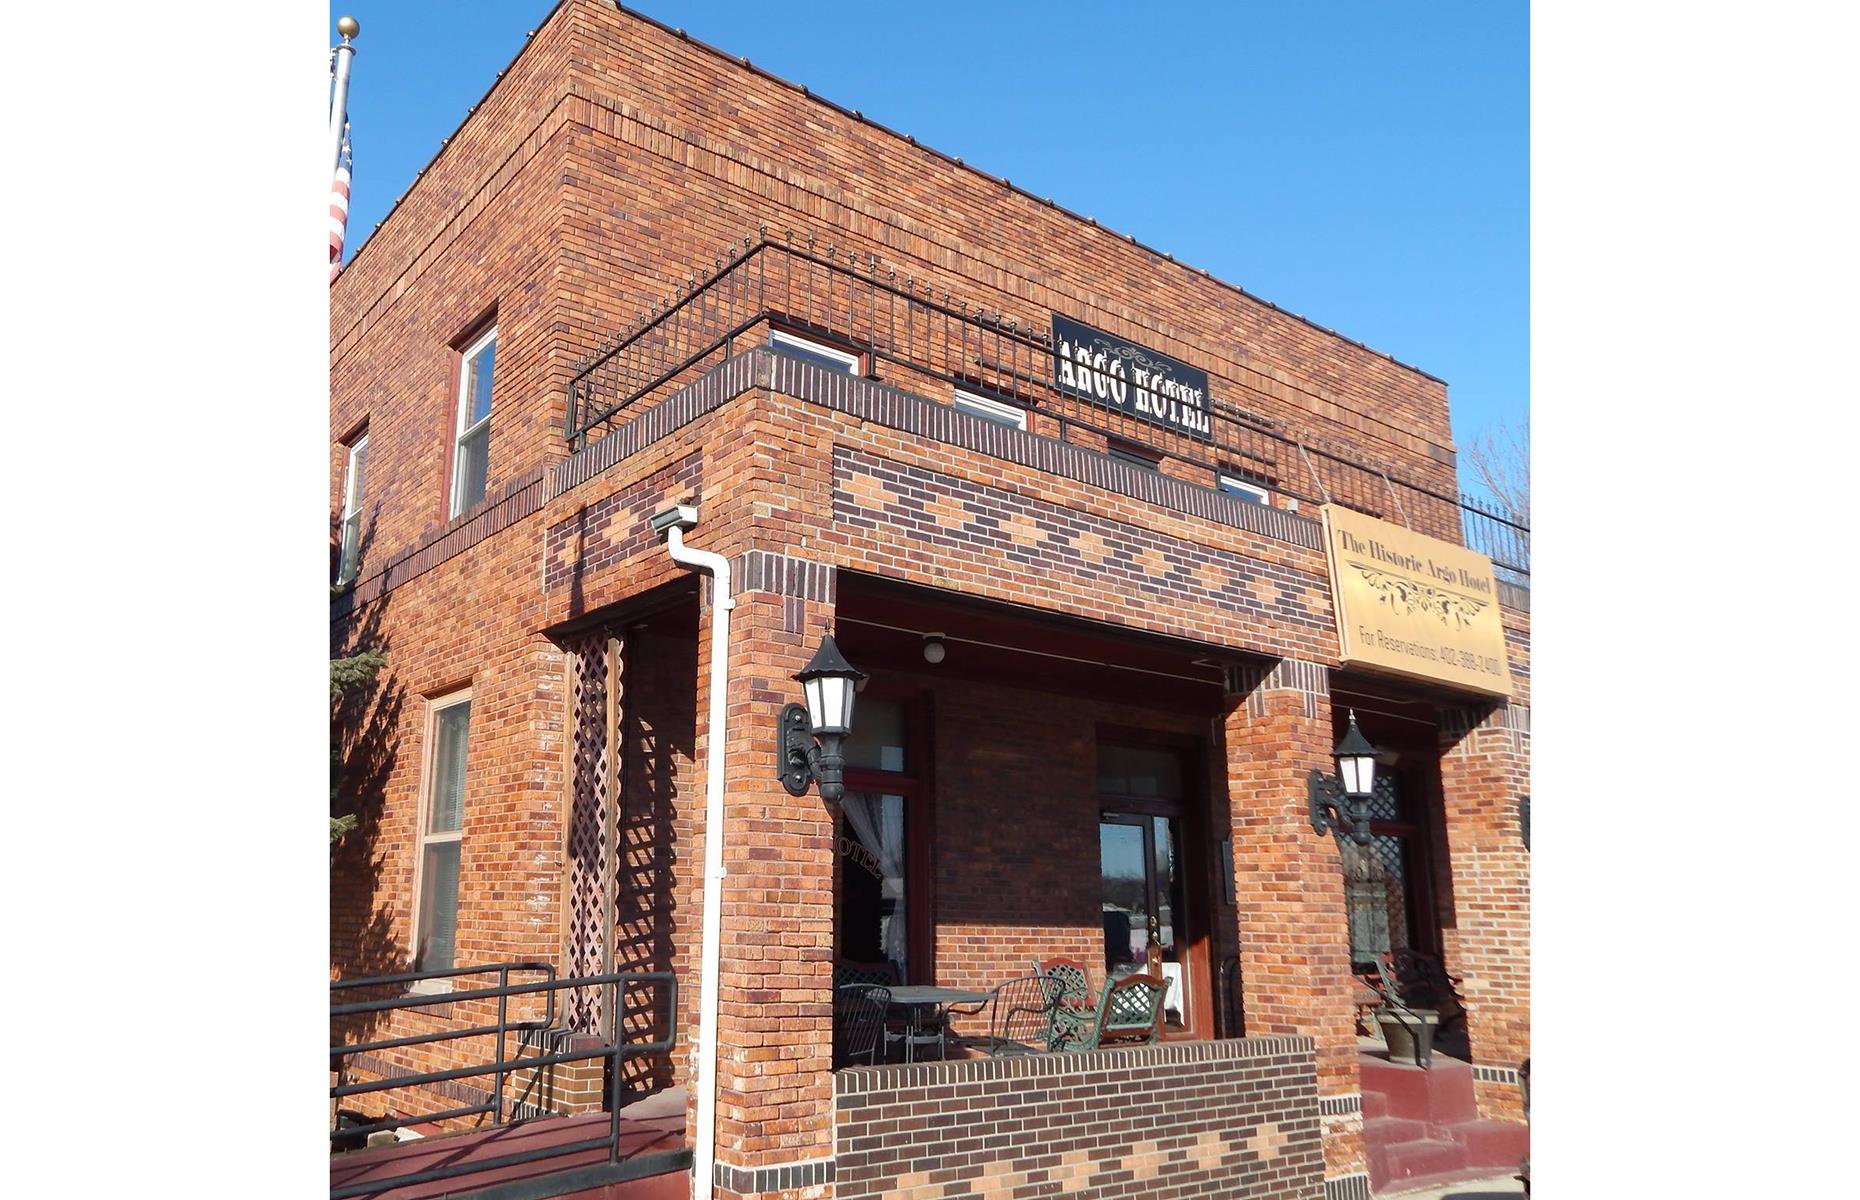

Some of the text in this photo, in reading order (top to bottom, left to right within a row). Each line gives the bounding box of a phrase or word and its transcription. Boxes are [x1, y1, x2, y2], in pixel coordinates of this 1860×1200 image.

[1058, 341, 1210, 434] ARGO HOTEL
[1337, 529, 1491, 594] The Historic Argo Hotel
[1359, 625, 1375, 646] For
[833, 835, 882, 879] OTEL
